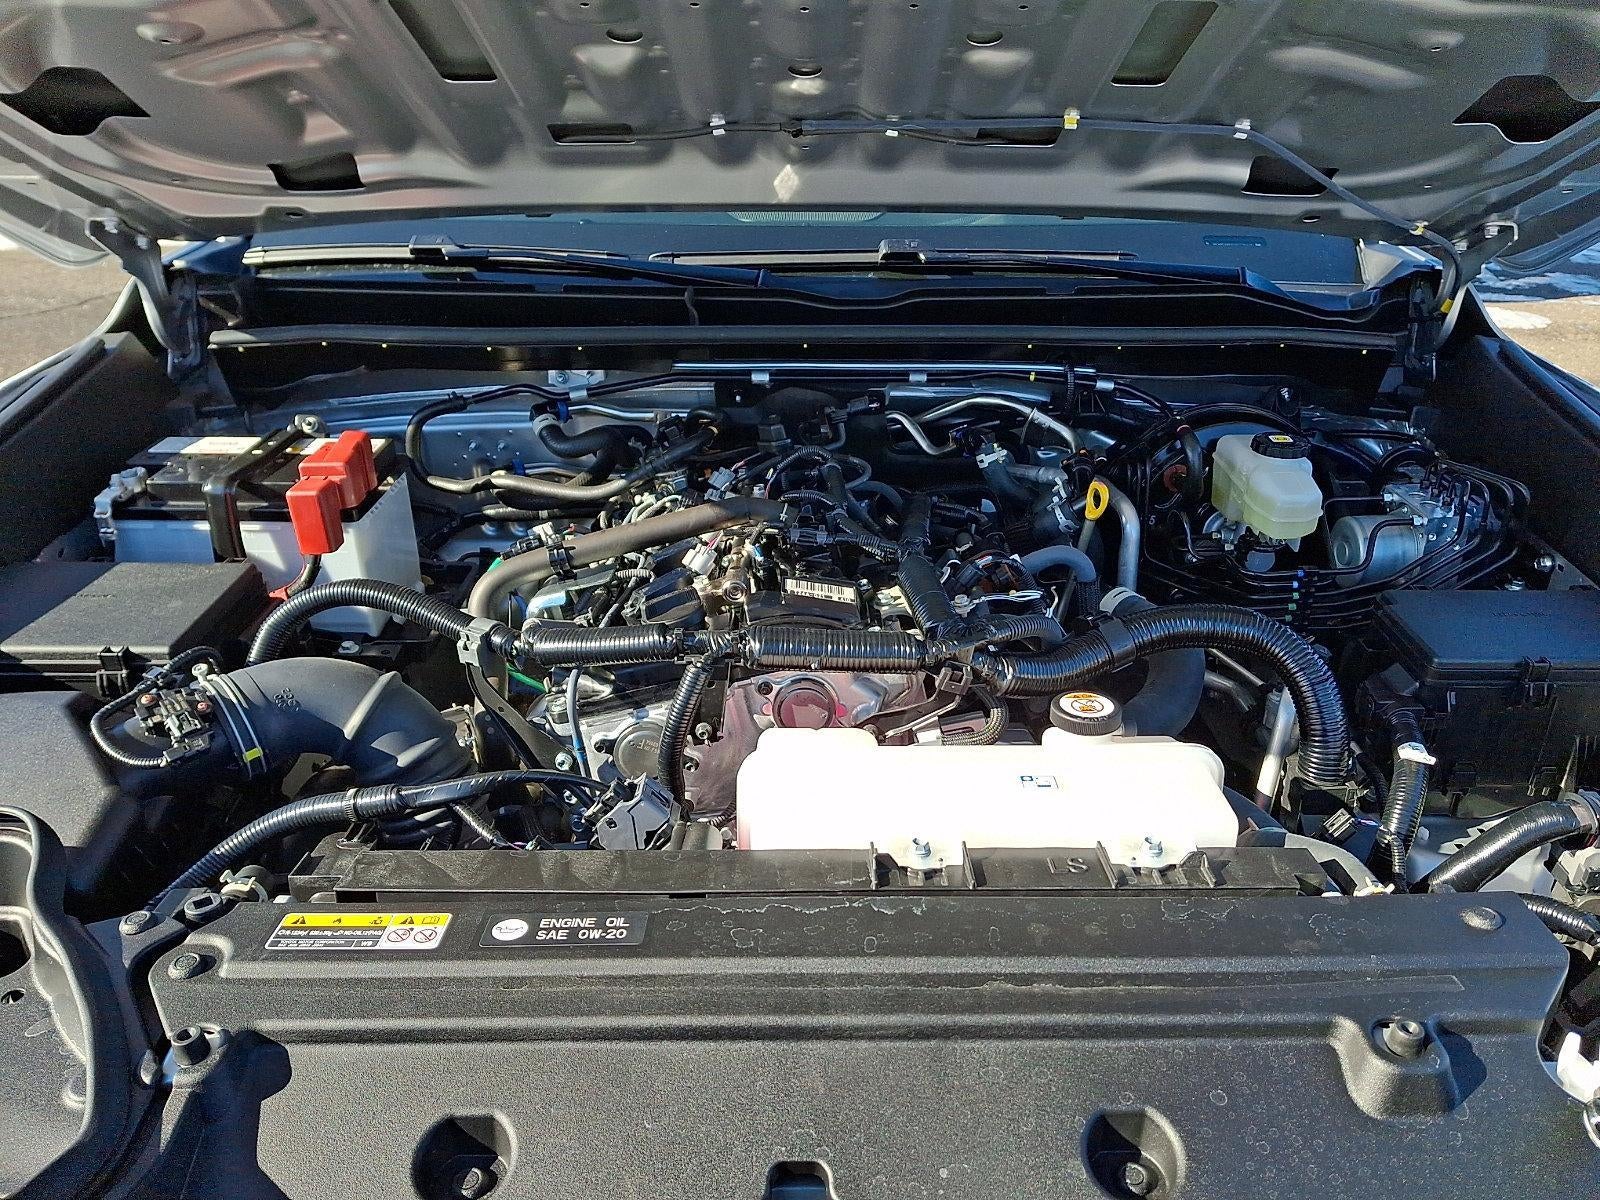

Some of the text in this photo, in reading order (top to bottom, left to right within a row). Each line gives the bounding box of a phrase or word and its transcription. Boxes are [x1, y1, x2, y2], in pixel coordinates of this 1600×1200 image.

[539, 917, 630, 928] ENGINE OIL
[535, 928, 628, 940] SAE 0W-20
